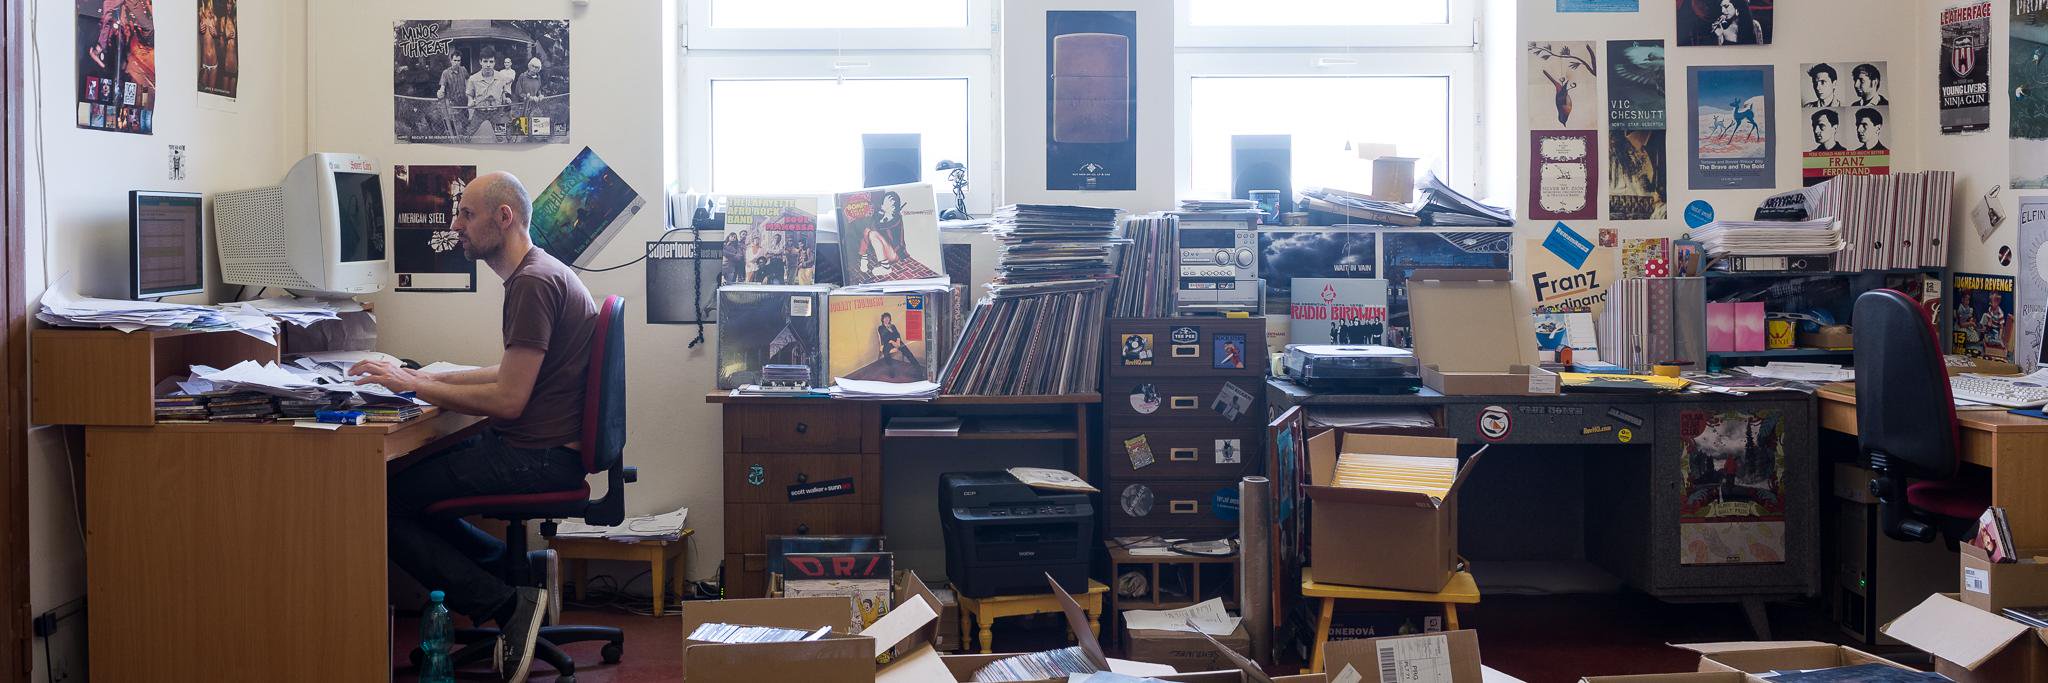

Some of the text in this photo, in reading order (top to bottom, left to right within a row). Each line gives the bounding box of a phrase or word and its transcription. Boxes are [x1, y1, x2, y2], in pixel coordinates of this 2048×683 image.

[1940, 3, 1991, 25] LEATHERFACE
[401, 23, 439, 41] MINOR
[399, 38, 453, 57] THREAT
[1942, 82, 1987, 96] YOUNG LIVERS
[1611, 100, 1630, 108] VIC
[1944, 94, 1985, 107] NINJA GUN
[1611, 110, 1663, 120] CHESNUTT
[1829, 157, 1864, 166] FRANZ
[1822, 168, 1870, 176] FERDINAND
[398, 212, 446, 224] AMERICAN STEEL
[728, 207, 780, 216] AFRO ROCK
[2022, 210, 2046, 224] ELFIN
[728, 216, 752, 224] BAND
[1532, 270, 1600, 302] Franz
[1984, 278, 2013, 292] REVENGE
[1290, 304, 1386, 321] RADIO BIRDMAN
[790, 488, 806, 496] scott
[806, 486, 824, 494] walker
